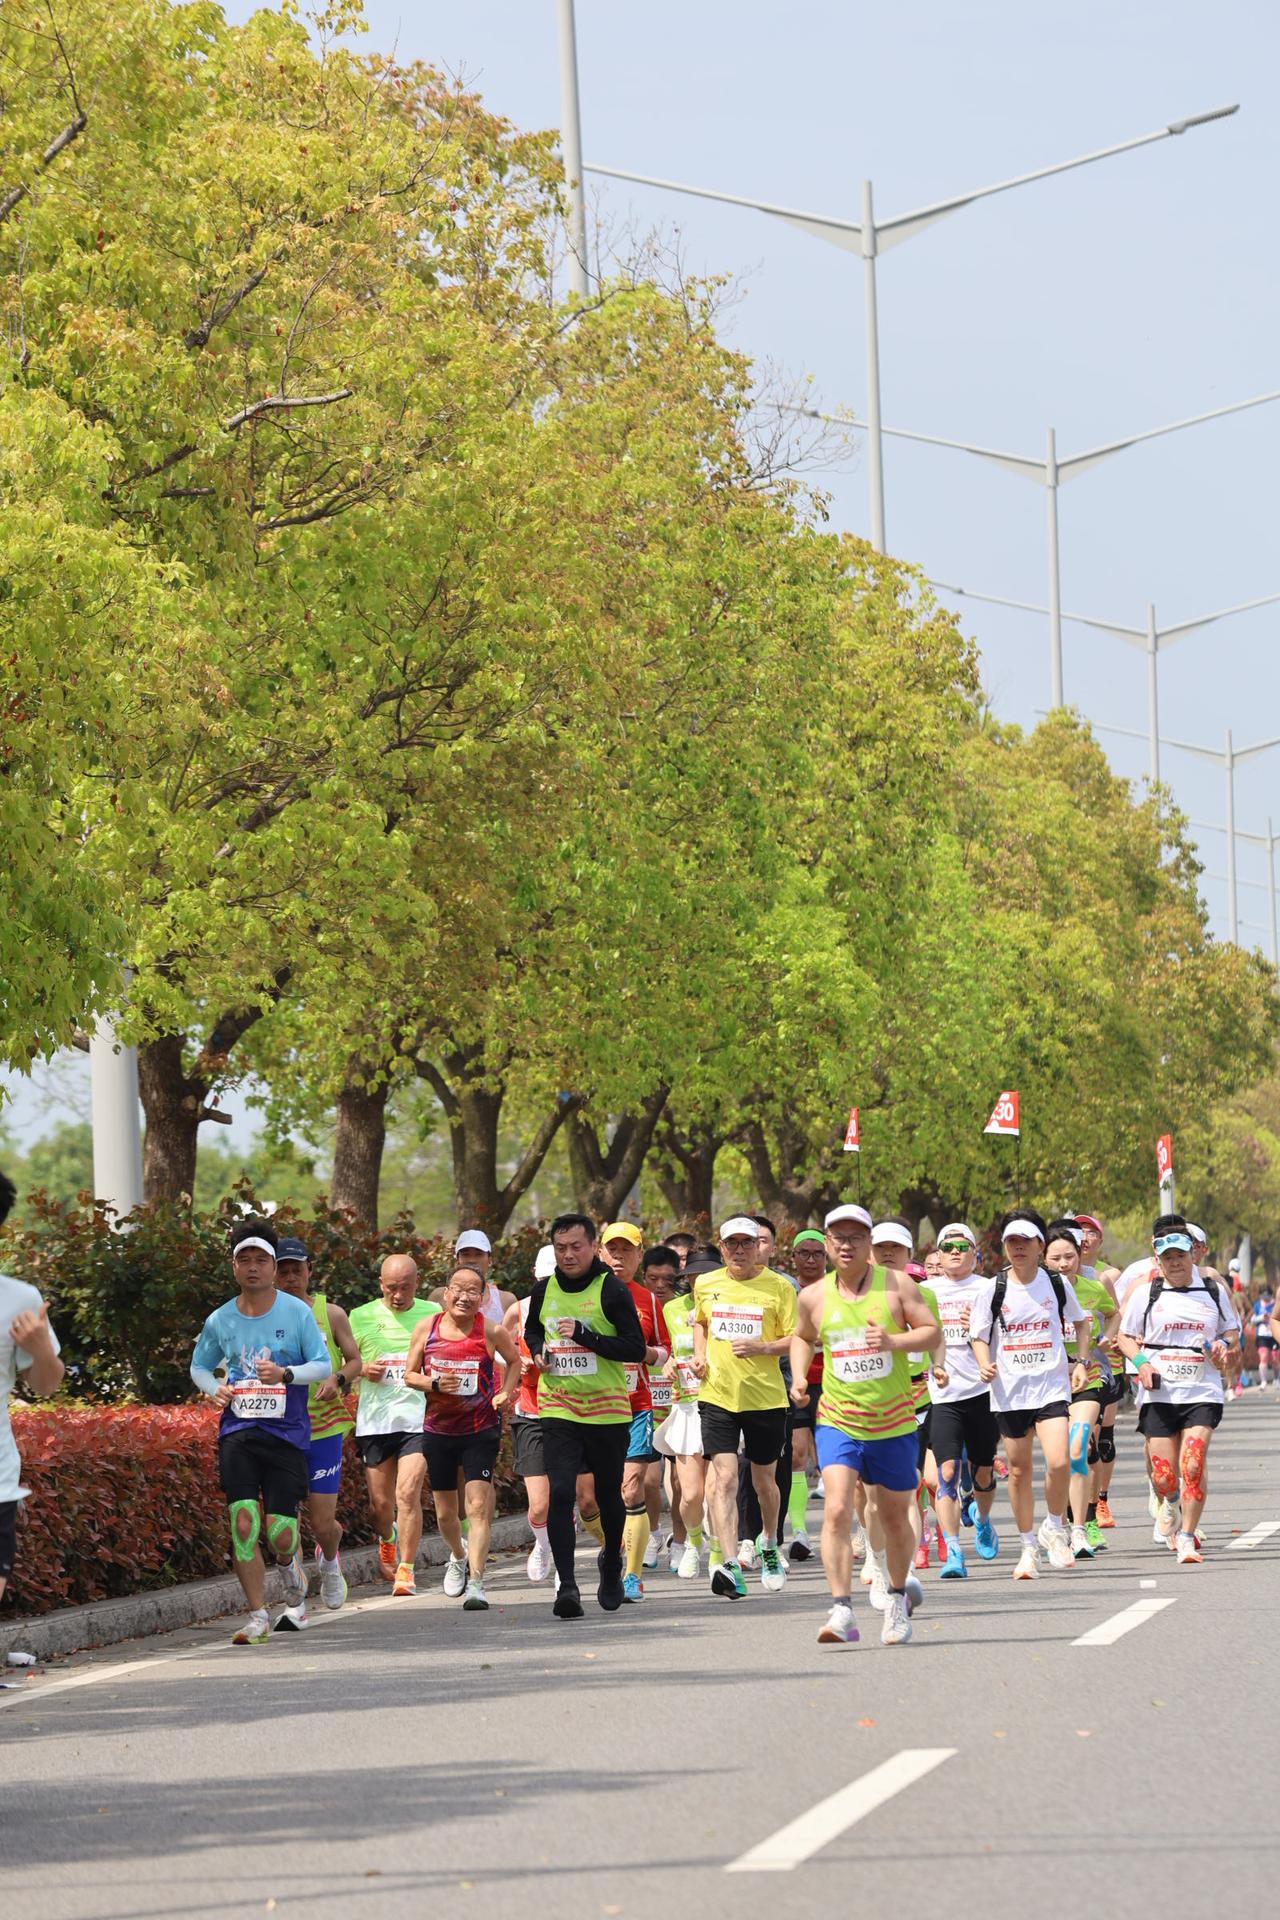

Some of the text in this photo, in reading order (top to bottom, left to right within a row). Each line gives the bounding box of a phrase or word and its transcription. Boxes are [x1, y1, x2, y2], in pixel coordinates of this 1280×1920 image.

[719, 1322, 754, 1334] A3300
[1007, 1321, 1050, 1333] PACER
[1164, 1322, 1205, 1332] PACER
[555, 1356, 588, 1369] A0163
[1012, 1352, 1047, 1365] A0072
[843, 1357, 884, 1375] A3629
[1166, 1364, 1199, 1376] A3557
[239, 1397, 278, 1411] A2279
